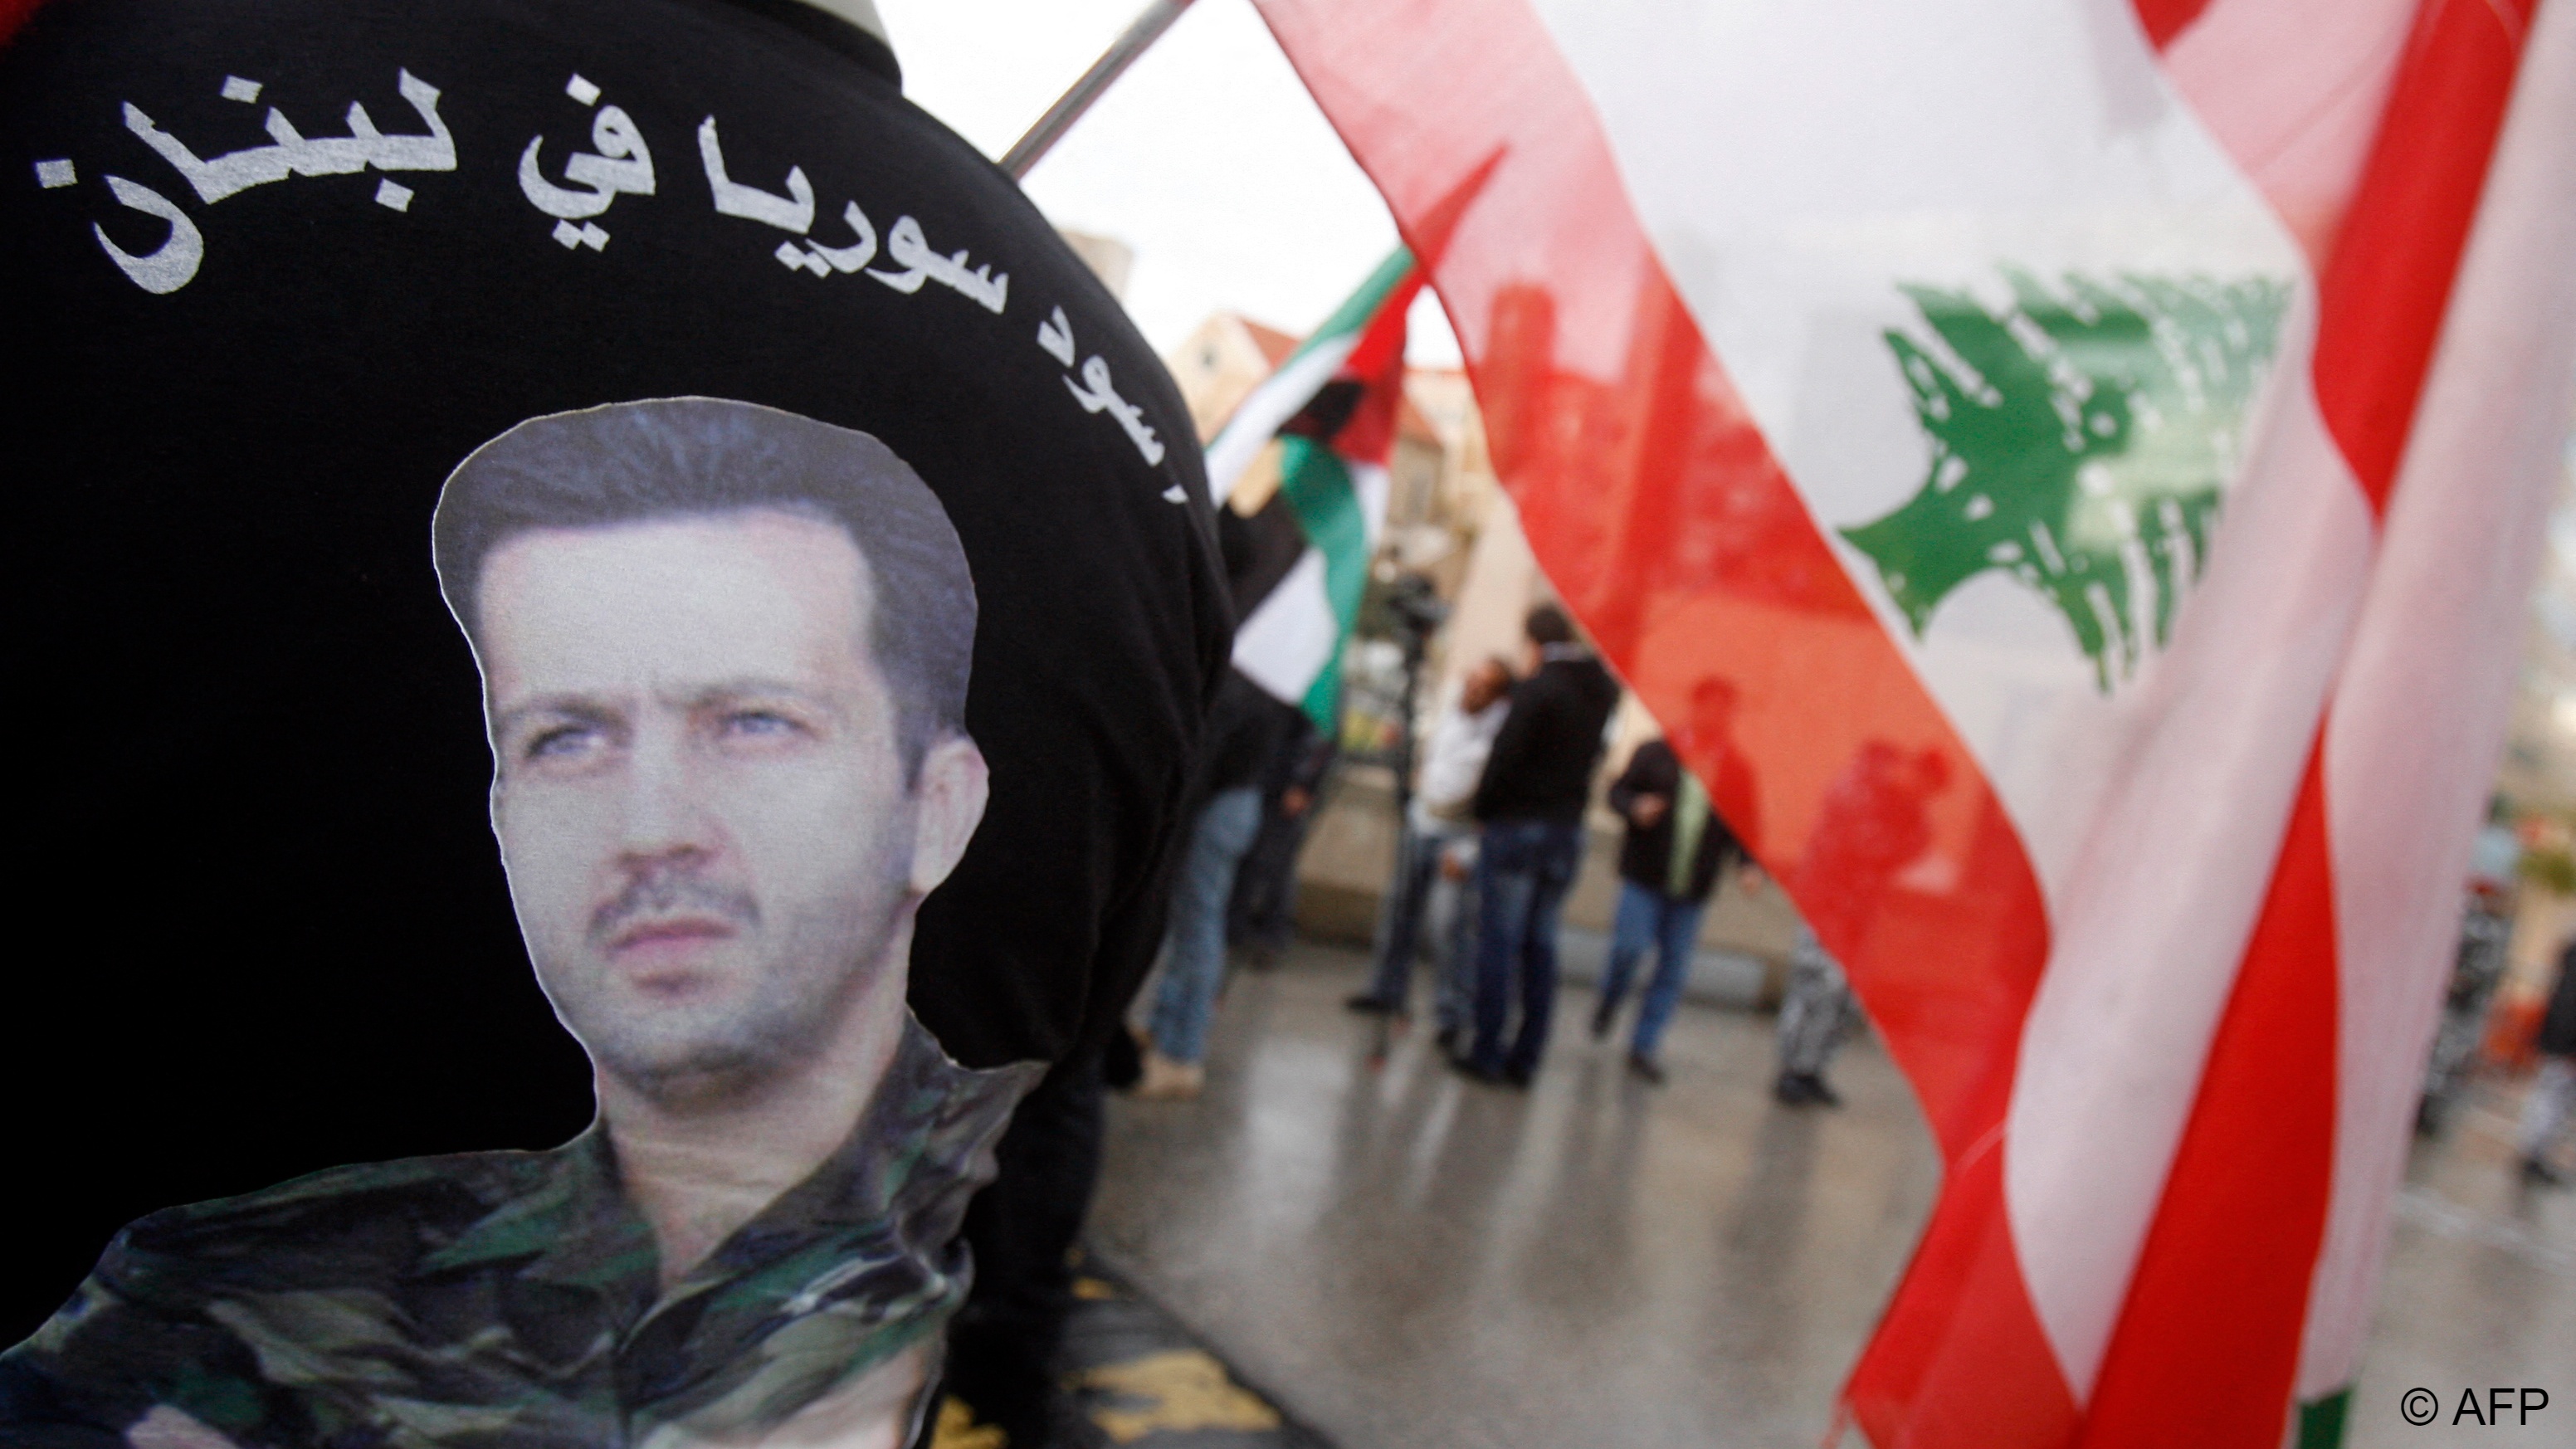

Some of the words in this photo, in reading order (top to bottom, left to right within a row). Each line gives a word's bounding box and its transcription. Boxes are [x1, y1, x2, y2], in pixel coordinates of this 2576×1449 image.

[36, 67, 457, 295] لبنان
[519, 73, 656, 251] في
[698, 115, 1008, 314] سوريا
